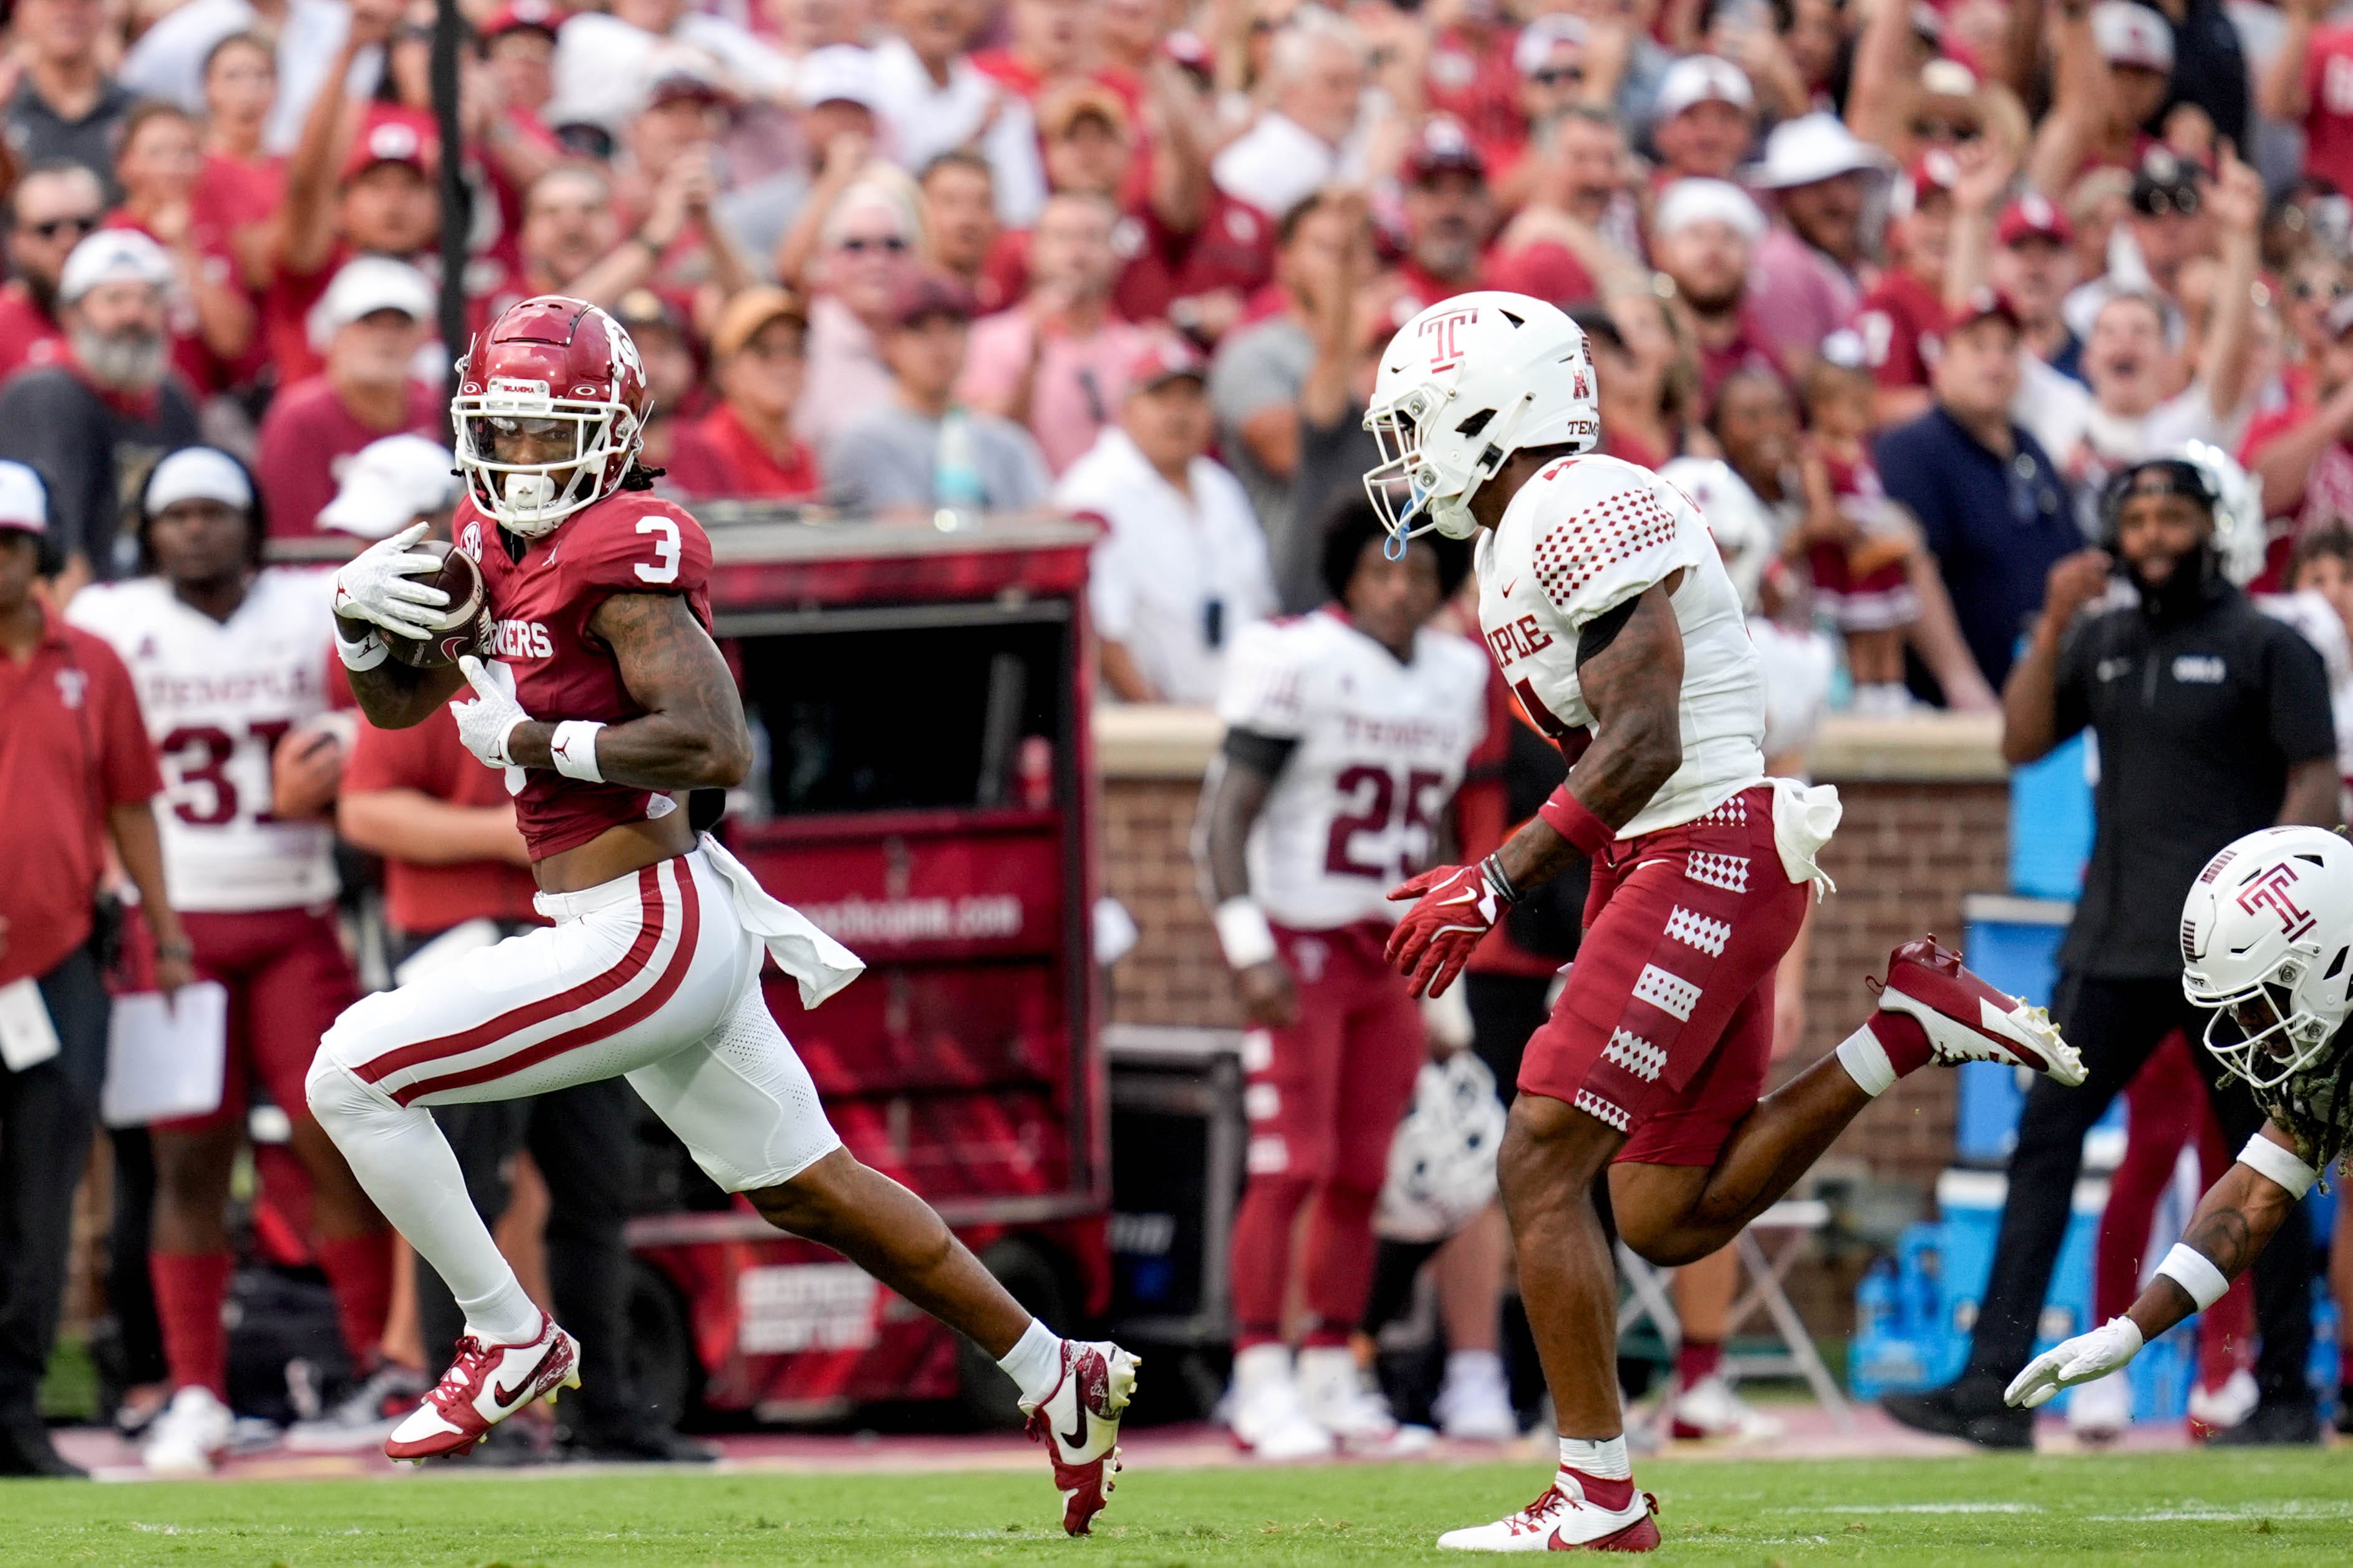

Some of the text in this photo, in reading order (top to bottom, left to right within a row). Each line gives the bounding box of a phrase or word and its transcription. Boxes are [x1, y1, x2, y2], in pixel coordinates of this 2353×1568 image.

[1418, 307, 1479, 374] T
[503, 385, 535, 394] OKLAHOMA
[634, 515, 682, 584] 3
[1324, 764, 1445, 882] 25
[2236, 862, 2317, 944] T
